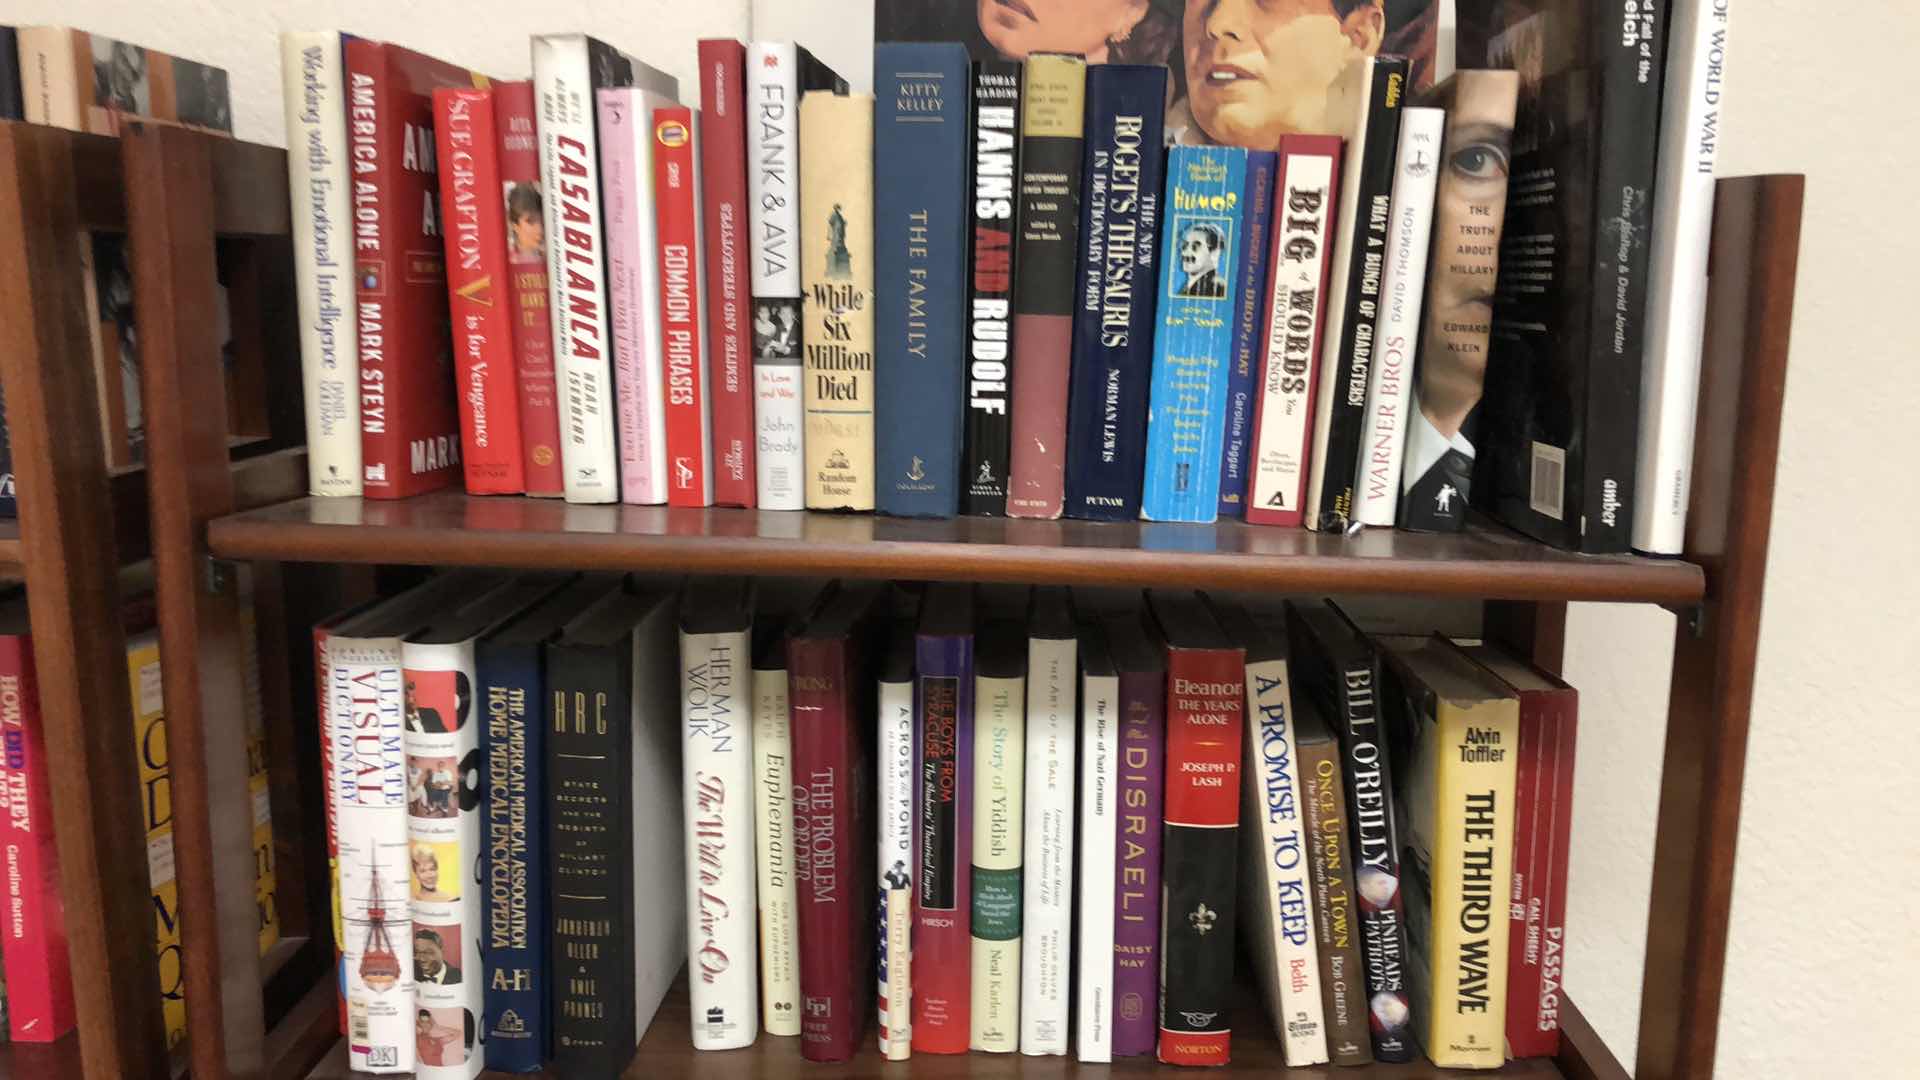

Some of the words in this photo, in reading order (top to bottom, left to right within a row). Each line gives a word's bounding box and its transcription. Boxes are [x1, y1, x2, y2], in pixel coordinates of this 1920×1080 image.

[1640, 13, 1655, 39] Fall
[1637, 58, 1651, 84] the
[1639, 42, 1651, 58] of
[300, 46, 327, 125] Working
[899, 83, 941, 97] KITTY
[976, 88, 1017, 100] HARDING
[978, 75, 1017, 87] THOMAS
[352, 72, 378, 174] AMERICA
[447, 98, 473, 148] SUE
[896, 100, 944, 112] KELLEY
[308, 129, 332, 172] with
[760, 84, 785, 185] FRANK
[975, 106, 1015, 219] HANNS
[1094, 149, 1109, 168] IN
[1110, 115, 1144, 214] ROGET'S
[310, 179, 339, 267] Emotional
[355, 181, 380, 250] ALONE
[452, 150, 482, 271] GRAFTON
[761, 192, 785, 213] &
[1088, 174, 1107, 267] DICTIONARY
[1141, 193, 1156, 234] THE
[1369, 194, 1390, 232] WHAT
[1469, 206, 1490, 216] THE
[1621, 186, 1634, 218] Chris
[908, 209, 928, 258] THE
[1284, 186, 1323, 263] BIG
[1367, 238, 1383, 248] A
[1395, 207, 1416, 275] THOMSON
[1459, 225, 1496, 236] TRUTH
[558, 135, 601, 360] CASABLANCA
[719, 202, 736, 300] STEREOTYPES
[763, 220, 787, 278] AVA
[1138, 234, 1153, 267] NEW
[1456, 245, 1493, 256] ABOUT
[664, 244, 690, 322] COMMON
[1085, 270, 1101, 311] FORM
[1101, 217, 1138, 347] THESAURUS
[1361, 252, 1382, 295] BUNCH
[1450, 265, 1495, 275] HILLARY
[813, 284, 864, 312] While
[907, 269, 928, 359] FAMILY
[1273, 284, 1289, 344] SHOULD
[1358, 300, 1376, 319] OF
[1391, 278, 1407, 322] DAVID
[1615, 276, 1629, 312] David
[314, 274, 341, 369] Intelligence
[360, 302, 384, 361] MARK
[723, 303, 737, 331] AND
[823, 314, 851, 342] Six
[1443, 322, 1489, 333] EDWARD
[1613, 312, 1627, 354] Jordan
[724, 334, 738, 392] SEMITES
[807, 344, 872, 372] Million
[970, 298, 1009, 415] RUDOLF
[1281, 288, 1316, 396] WORDS
[1447, 343, 1480, 353] KLEIN
[668, 329, 693, 405] PHRASES
[1268, 350, 1282, 395] KNOW
[1347, 323, 1373, 407] CHARACTERS!
[1380, 336, 1406, 397] BROS
[362, 368, 386, 434] STEYN
[567, 370, 585, 444] ISENBERG
[583, 372, 598, 415] NOAH
[817, 375, 858, 400] Died
[1105, 368, 1121, 421] NORMAN
[763, 416, 795, 433] John
[1232, 391, 1247, 437] Caroline
[410, 434, 460, 474] MARK
[1102, 425, 1117, 463] LEWIS
[1228, 438, 1243, 479] Taggart
[1367, 403, 1397, 500] WARNER
[818, 473, 857, 484] Random
[822, 484, 852, 496] House
[1086, 496, 1124, 507] PUTNAM
[1601, 479, 1621, 528] amber
[509, 688, 525, 717] THE
[688, 663, 709, 738] WOUK
[710, 647, 733, 753] HERMAN
[994, 690, 1009, 718] The
[1174, 679, 1242, 696] Eleanor
[1178, 699, 1201, 711] THE
[1204, 700, 1240, 712] YEARS
[1255, 675, 1282, 697] A
[1345, 669, 1375, 736] BILL
[488, 685, 508, 738] HOME
[1097, 700, 1107, 718] The
[1097, 719, 1106, 738] Rise
[1187, 713, 1229, 725] ALONE
[335, 668, 357, 803] DICTIONARY
[351, 671, 383, 804] VISUAL
[378, 669, 404, 805] ULTIMATE
[509, 719, 526, 792] AMERICAN
[992, 726, 1009, 769] Story
[1096, 740, 1106, 751] of
[1458, 745, 1506, 764] Toffler
[1464, 727, 1501, 745] Alvin
[490, 742, 510, 820] MEDICAL
[924, 762, 936, 781] The
[993, 773, 1004, 791] of
[1096, 753, 1106, 772] Nazi
[1192, 776, 1222, 786] LASH
[1258, 702, 1296, 824] PROMISE
[792, 785, 810, 812] OF
[811, 767, 834, 811] THE
[1095, 775, 1106, 816] Germany
[1316, 759, 1334, 818] ONCE
[1352, 741, 1390, 871] O'REILLY
[510, 795, 527, 857] MEDICAL
[763, 752, 788, 888] Euphemania
[992, 796, 1008, 857] Yiddish
[1123, 747, 1148, 921] DISRAELI
[1464, 790, 1496, 843] THE
[793, 814, 811, 881] ORDER
[811, 814, 836, 903] PROBLEM
[922, 824, 936, 868] Theatrical
[1273, 829, 1301, 870] TO
[1320, 818, 1341, 870] UPON
[6, 844, 22, 896] Caroline
[491, 823, 511, 949] ENCYCLOPEDIA
[1327, 876, 1342, 887] A
[1460, 846, 1494, 935] THIRD
[12, 900, 24, 939] Sutton
[511, 860, 528, 949] ASSOCIATION
[922, 918, 954, 928] HIRSCH
[1277, 878, 1308, 946] KEEP
[1329, 890, 1349, 948] TOWN
[1529, 897, 1541, 922] GAIL
[895, 911, 905, 947] Terry
[1114, 943, 1152, 954] DAISY
[1380, 909, 1402, 992] PINHEADS
[1525, 925, 1540, 966] SHEEHY
[989, 949, 1002, 976] Neal
[1118, 959, 1145, 968] HAY
[1330, 956, 1344, 974] BOB
[1366, 919, 1387, 992] PATRIOTS
[491, 968, 532, 991] A-H
[895, 951, 905, 1008] Eagleton
[1457, 940, 1491, 1015] WAVE
[1537, 926, 1563, 1032] PASSAGES
[989, 980, 1001, 1019] Karlen
[1333, 979, 1349, 1026] GREENE
[1175, 1043, 1223, 1054] NORTON
